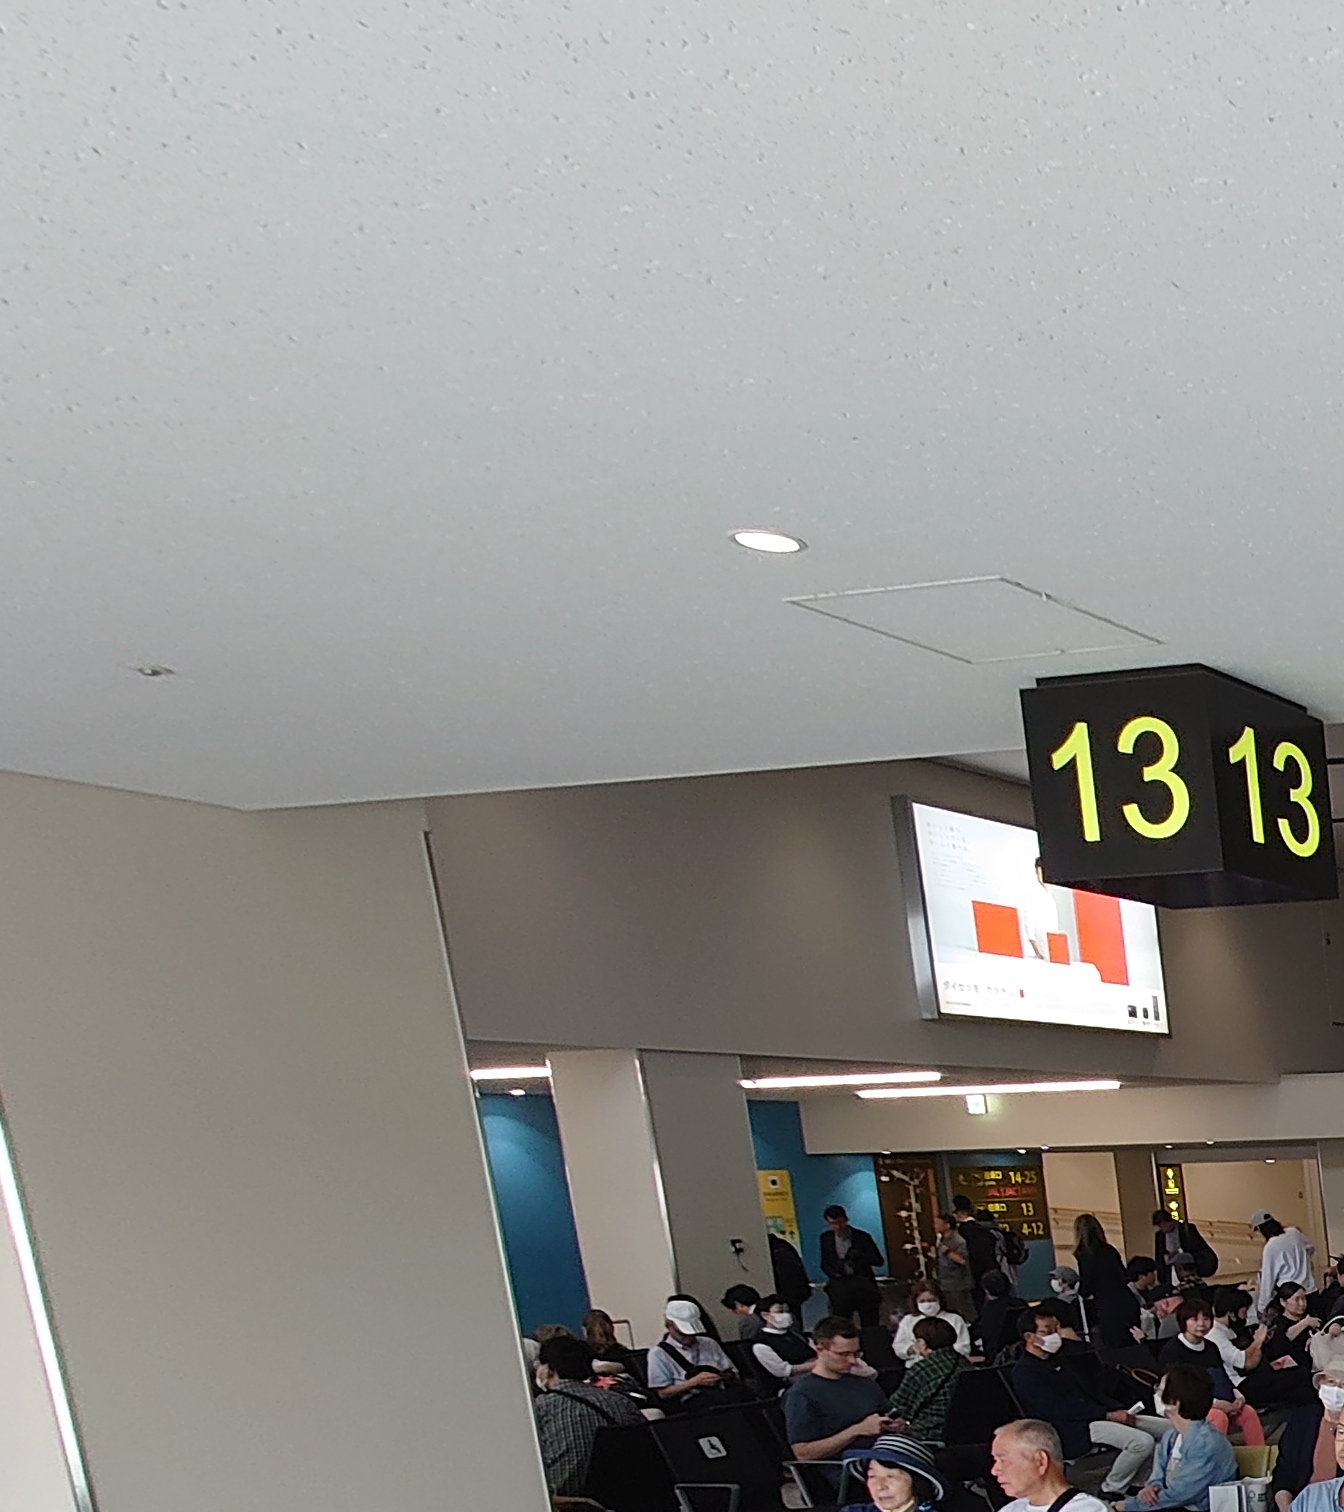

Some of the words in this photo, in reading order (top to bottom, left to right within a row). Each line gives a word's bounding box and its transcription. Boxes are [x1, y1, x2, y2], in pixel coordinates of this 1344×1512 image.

[1051, 716, 1190, 842] 13
[1228, 726, 1320, 858] 13
[1021, 1202, 1034, 1216] 13
[1021, 1222, 1045, 1235] 4-12
